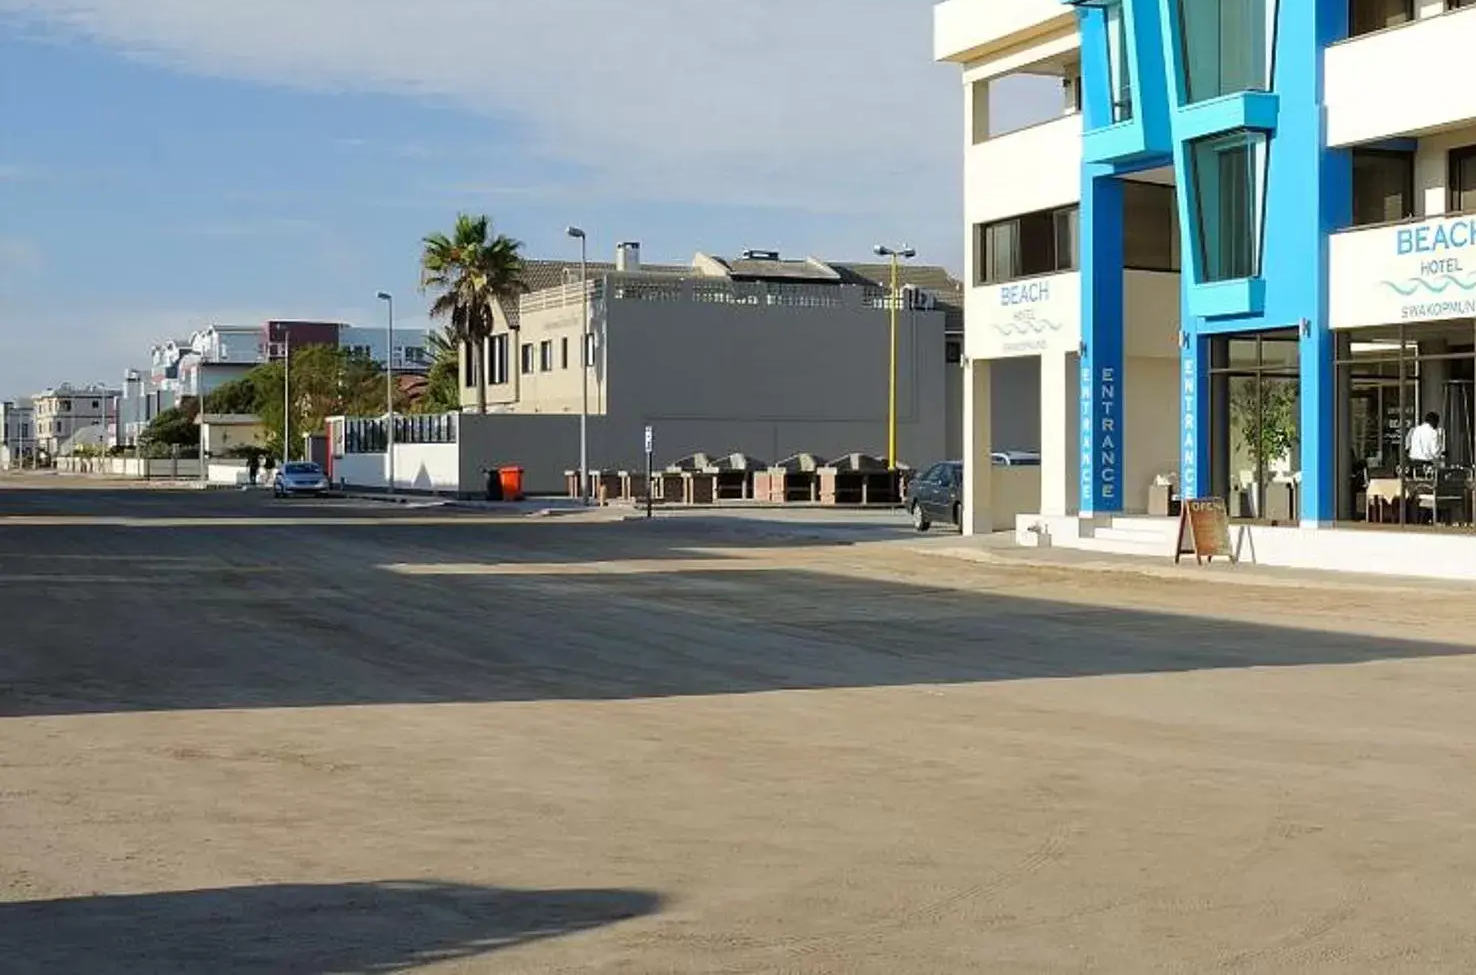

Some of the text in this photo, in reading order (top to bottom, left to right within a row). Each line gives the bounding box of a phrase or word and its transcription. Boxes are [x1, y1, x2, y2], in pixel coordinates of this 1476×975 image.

[1000, 281, 1049, 306] BEACH
[1420, 257, 1463, 276] HOTEL
[1080, 367, 1091, 500] ENTRANCE
[1101, 367, 1116, 498] ENTRANCE
[1184, 359, 1195, 499] ENTRANCE
